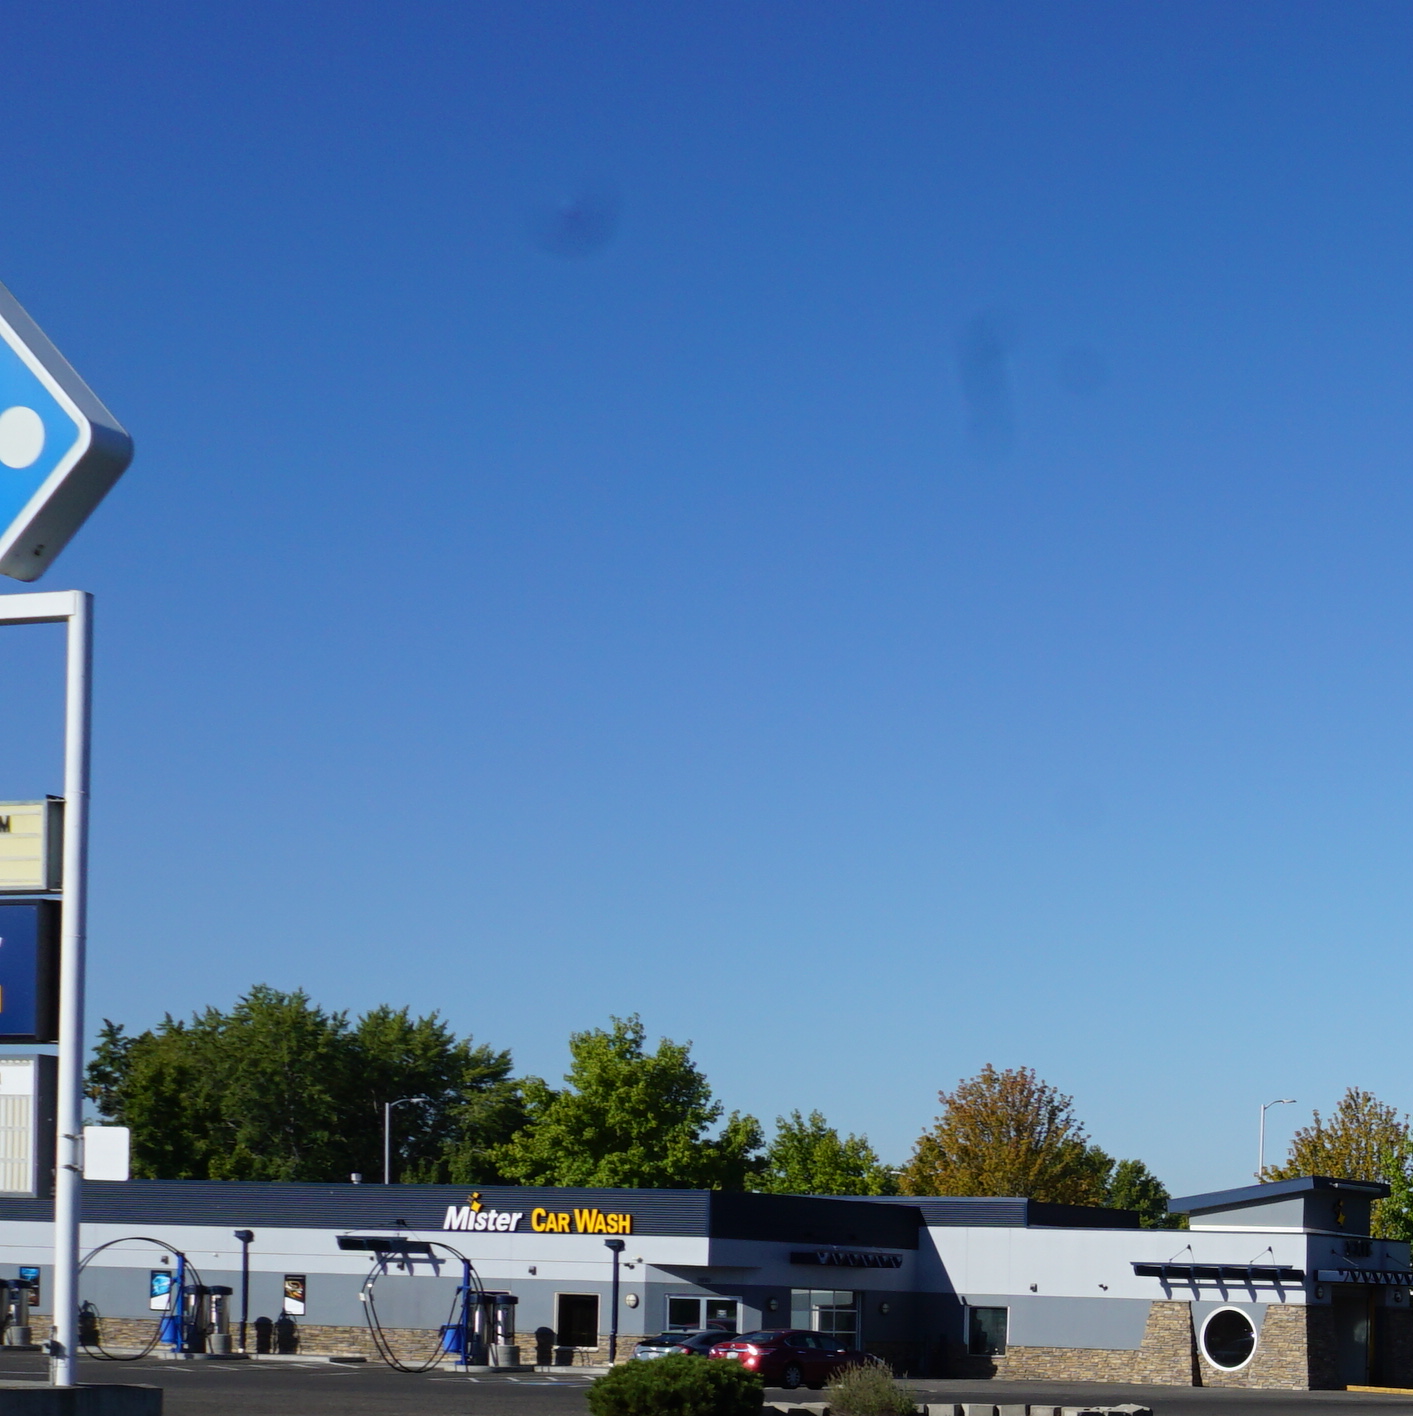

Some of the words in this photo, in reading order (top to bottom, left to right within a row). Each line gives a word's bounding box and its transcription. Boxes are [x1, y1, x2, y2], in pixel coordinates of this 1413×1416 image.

[442, 1201, 523, 1232] Mister
[531, 1207, 571, 1233] CAR
[573, 1208, 632, 1234] WASH
